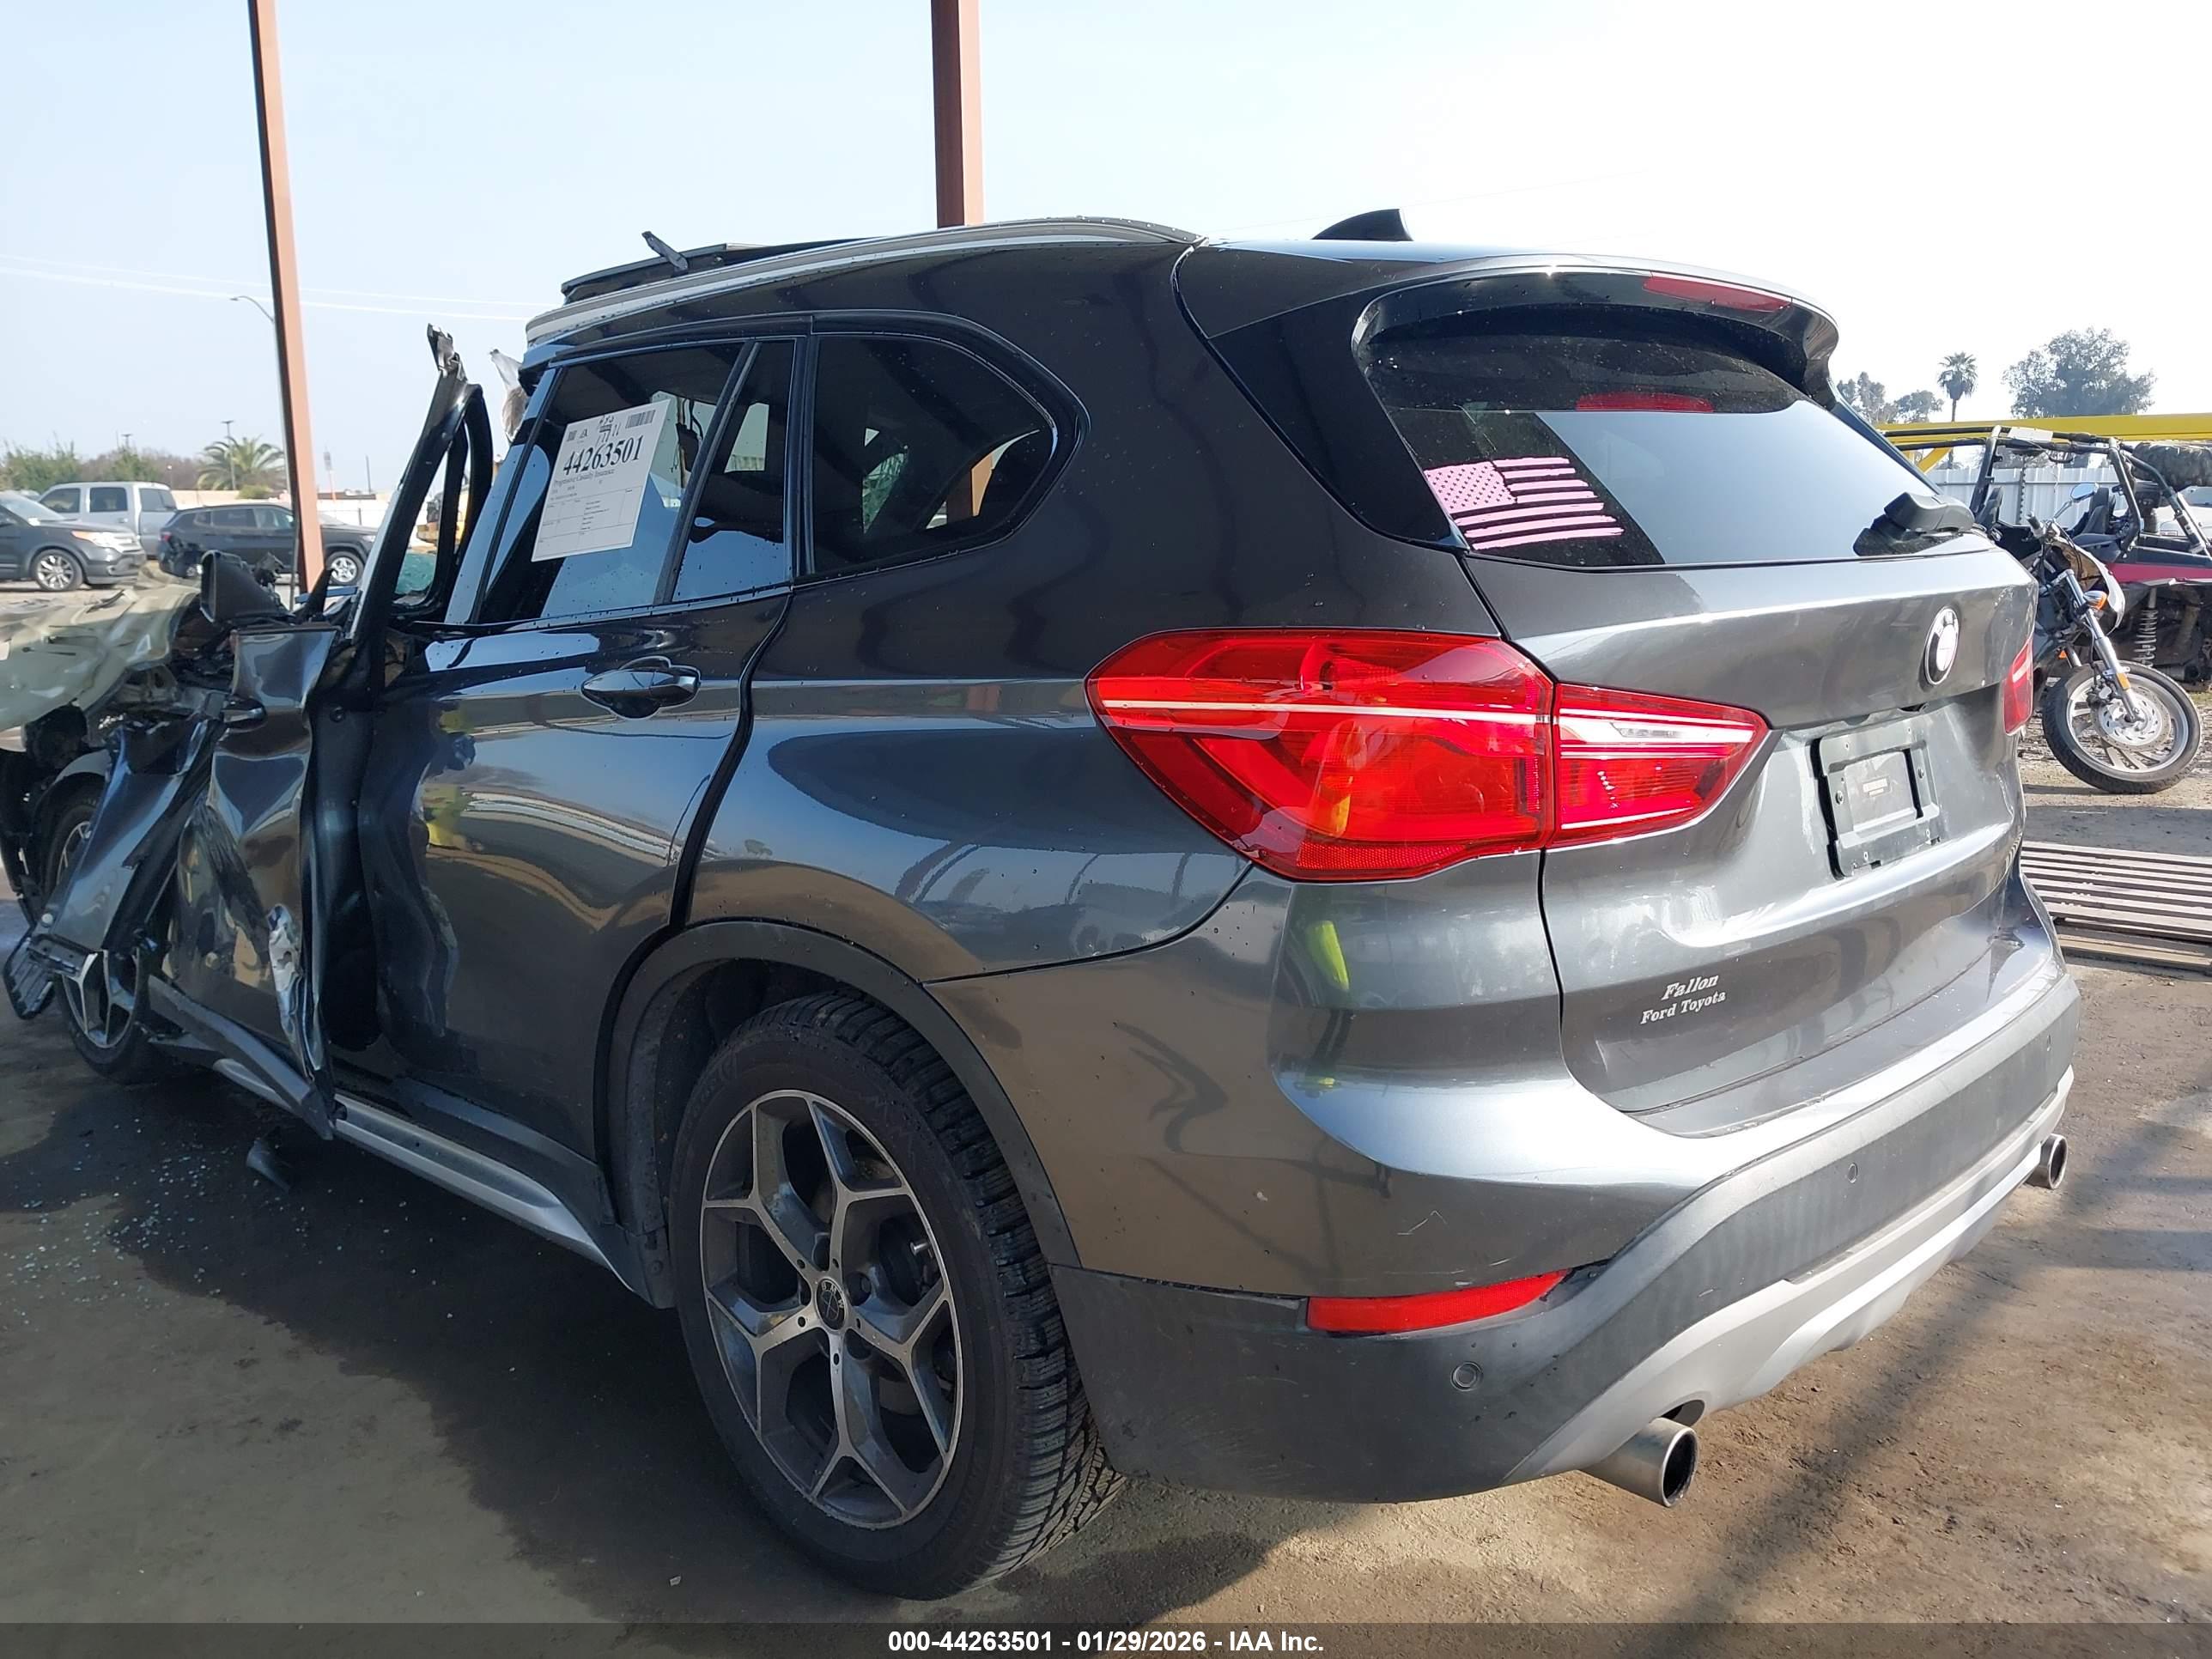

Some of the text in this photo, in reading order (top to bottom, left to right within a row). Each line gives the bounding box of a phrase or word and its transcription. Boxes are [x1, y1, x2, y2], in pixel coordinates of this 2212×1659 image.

[563, 434, 644, 476] 44263501
[1661, 975, 1719, 1000] Fallon
[1640, 991, 1726, 1024] Ford Toyota
